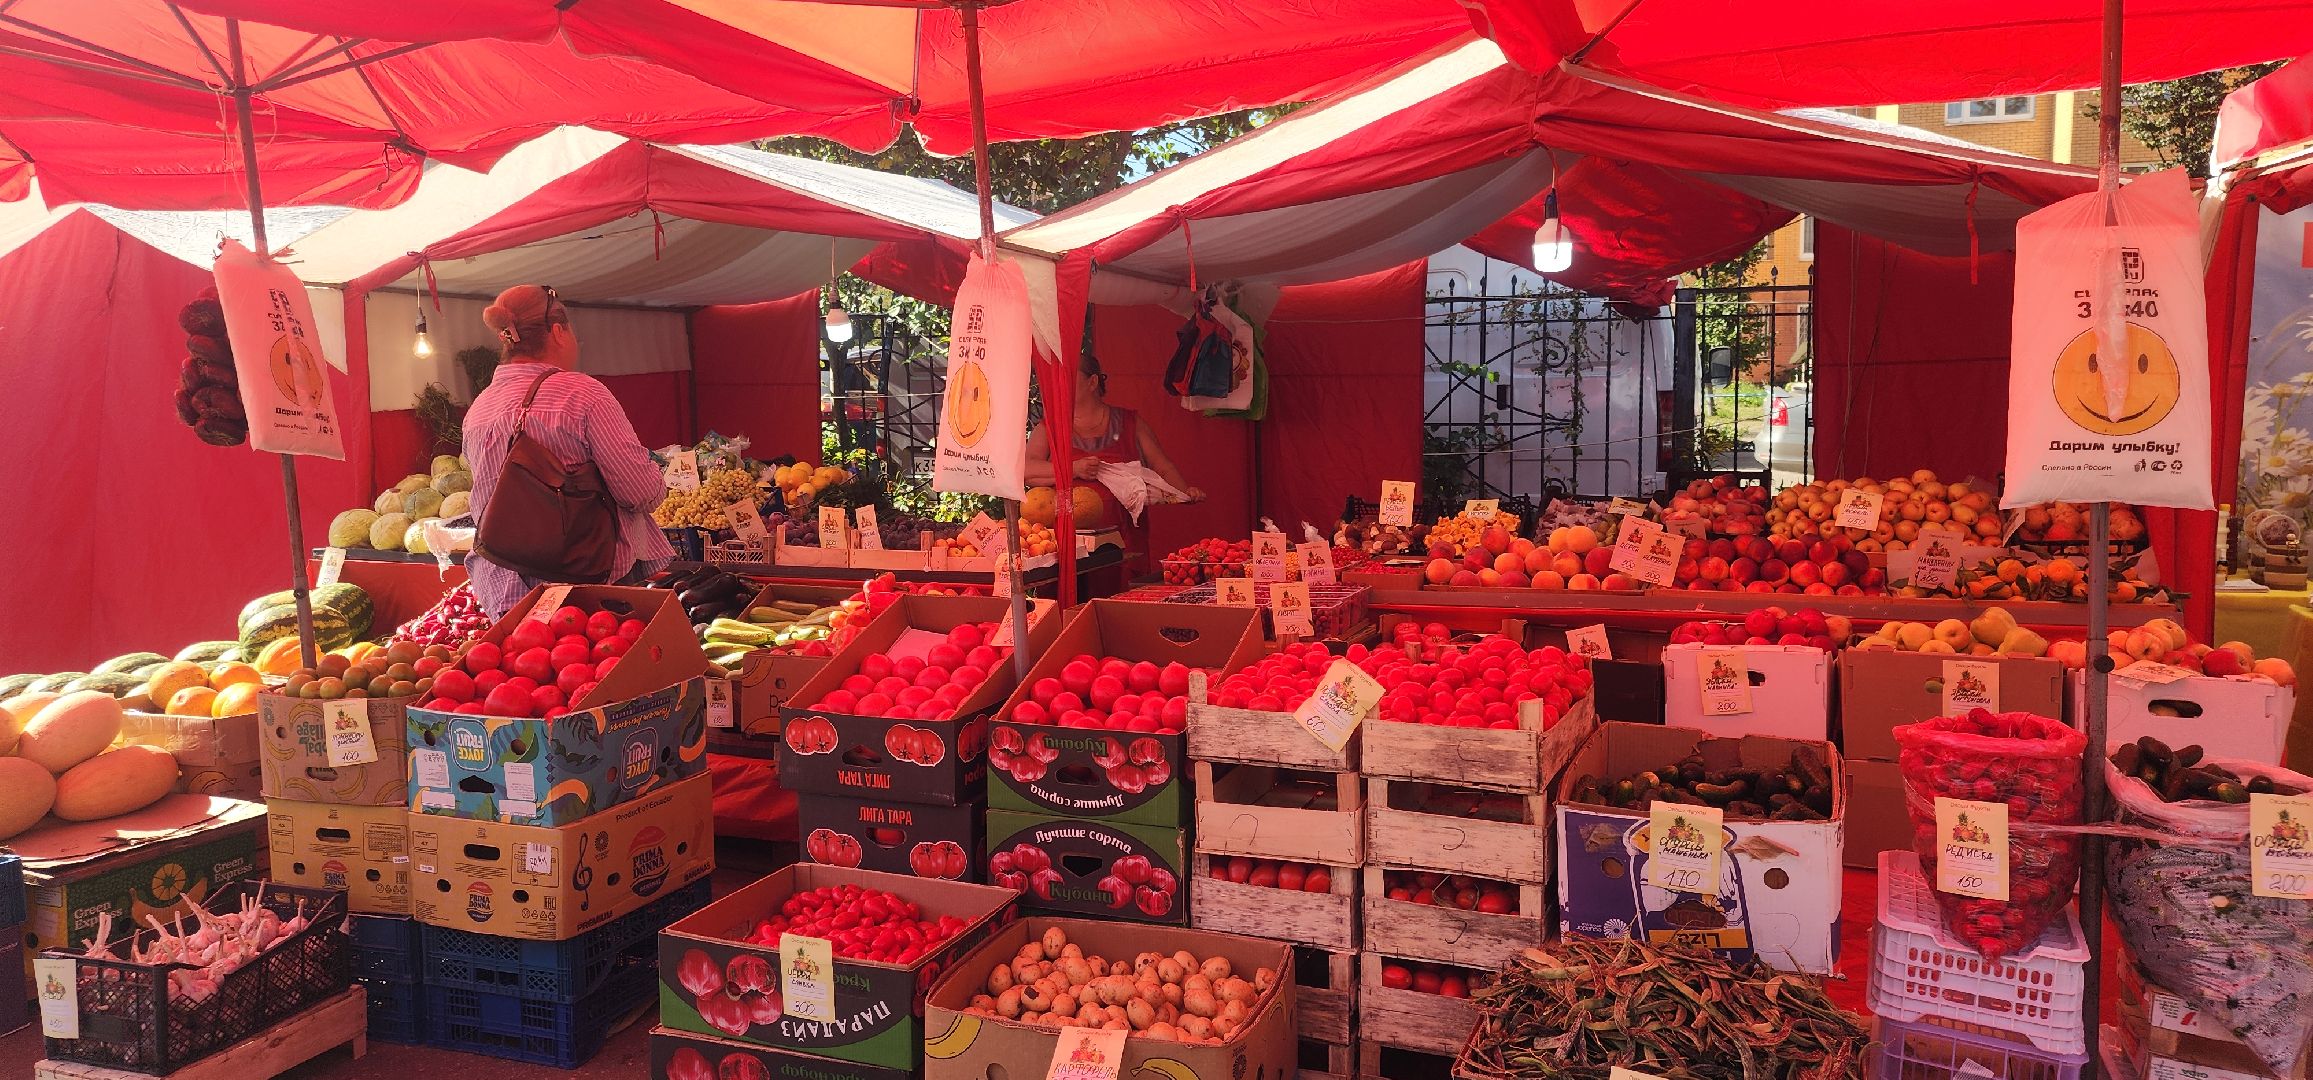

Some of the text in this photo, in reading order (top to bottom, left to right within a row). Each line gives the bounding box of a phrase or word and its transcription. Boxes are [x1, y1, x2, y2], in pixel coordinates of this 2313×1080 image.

[2049, 440, 2181, 456] Дарим улыбку!
[838, 769, 892, 789] ЛИГА ТАРА
[1030, 783, 1125, 809] Лучшие сорта
[858, 806, 913, 827] ЛИГА ТАРА
[1035, 829, 1133, 855] Лучшие сорта
[1945, 843, 1994, 861] РЕДИСКА
[213, 856, 244, 874] Green
[632, 846, 664, 868] PRIMA
[214, 863, 253, 883] Express
[633, 856, 666, 880] DONNA
[1664, 868, 1701, 888] 170
[1957, 875, 1983, 888] 150
[2269, 873, 2306, 892] 200
[469, 893, 491, 904] PRIMA
[1050, 882, 1113, 904] Кубани
[73, 901, 112, 919] Green
[468, 901, 491, 911] DONNA
[577, 910, 614, 932] PREMIUM
[793, 1000, 816, 1015] 300
